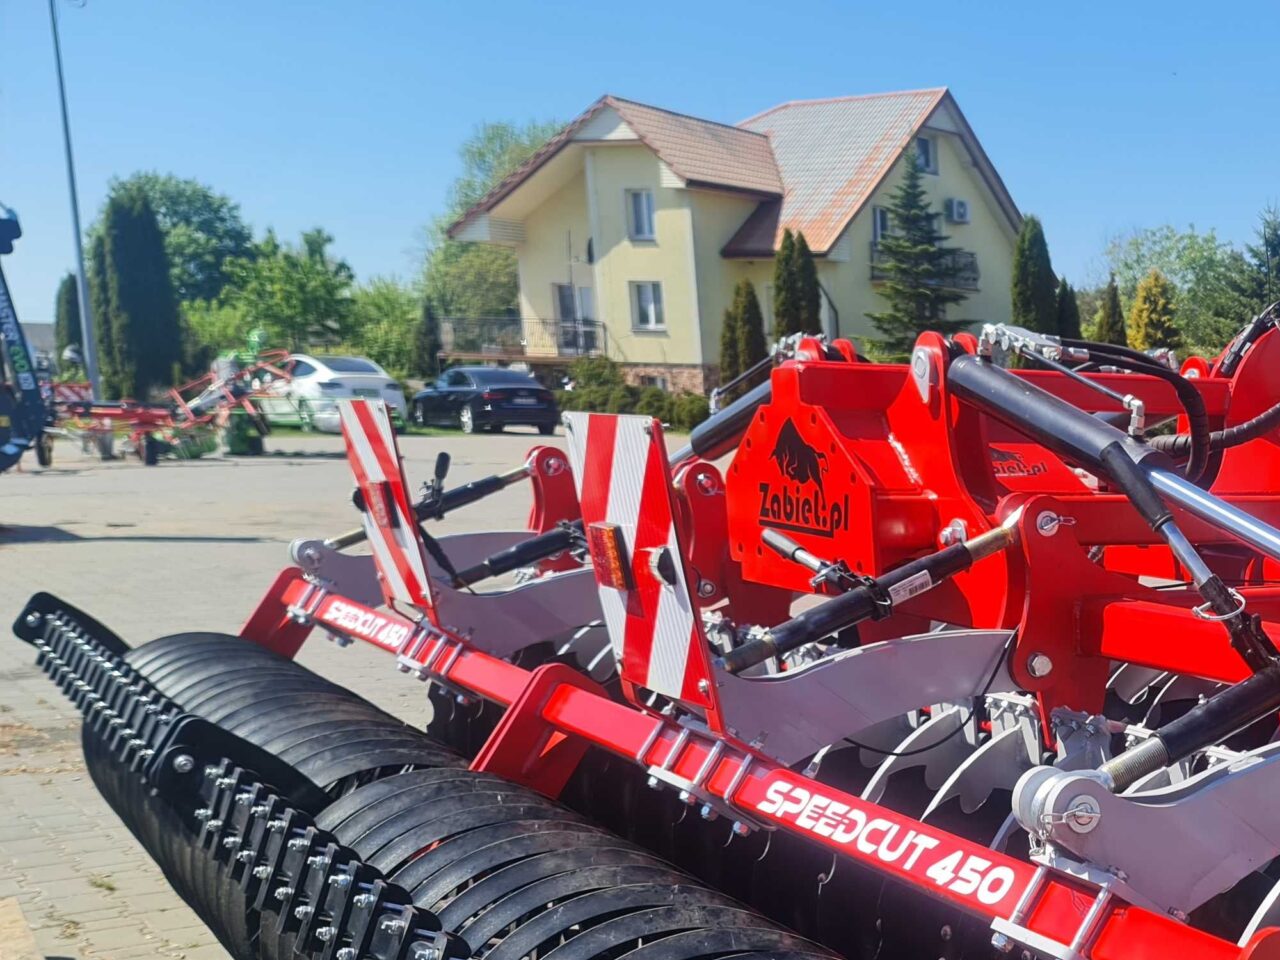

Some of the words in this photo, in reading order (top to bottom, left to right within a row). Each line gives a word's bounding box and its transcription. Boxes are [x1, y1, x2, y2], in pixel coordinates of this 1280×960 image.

[322, 600, 388, 639] SPEEDCUT
[377, 622, 409, 648] 450
[756, 780, 940, 870] SPEEDCUT
[926, 850, 1015, 904] 450
